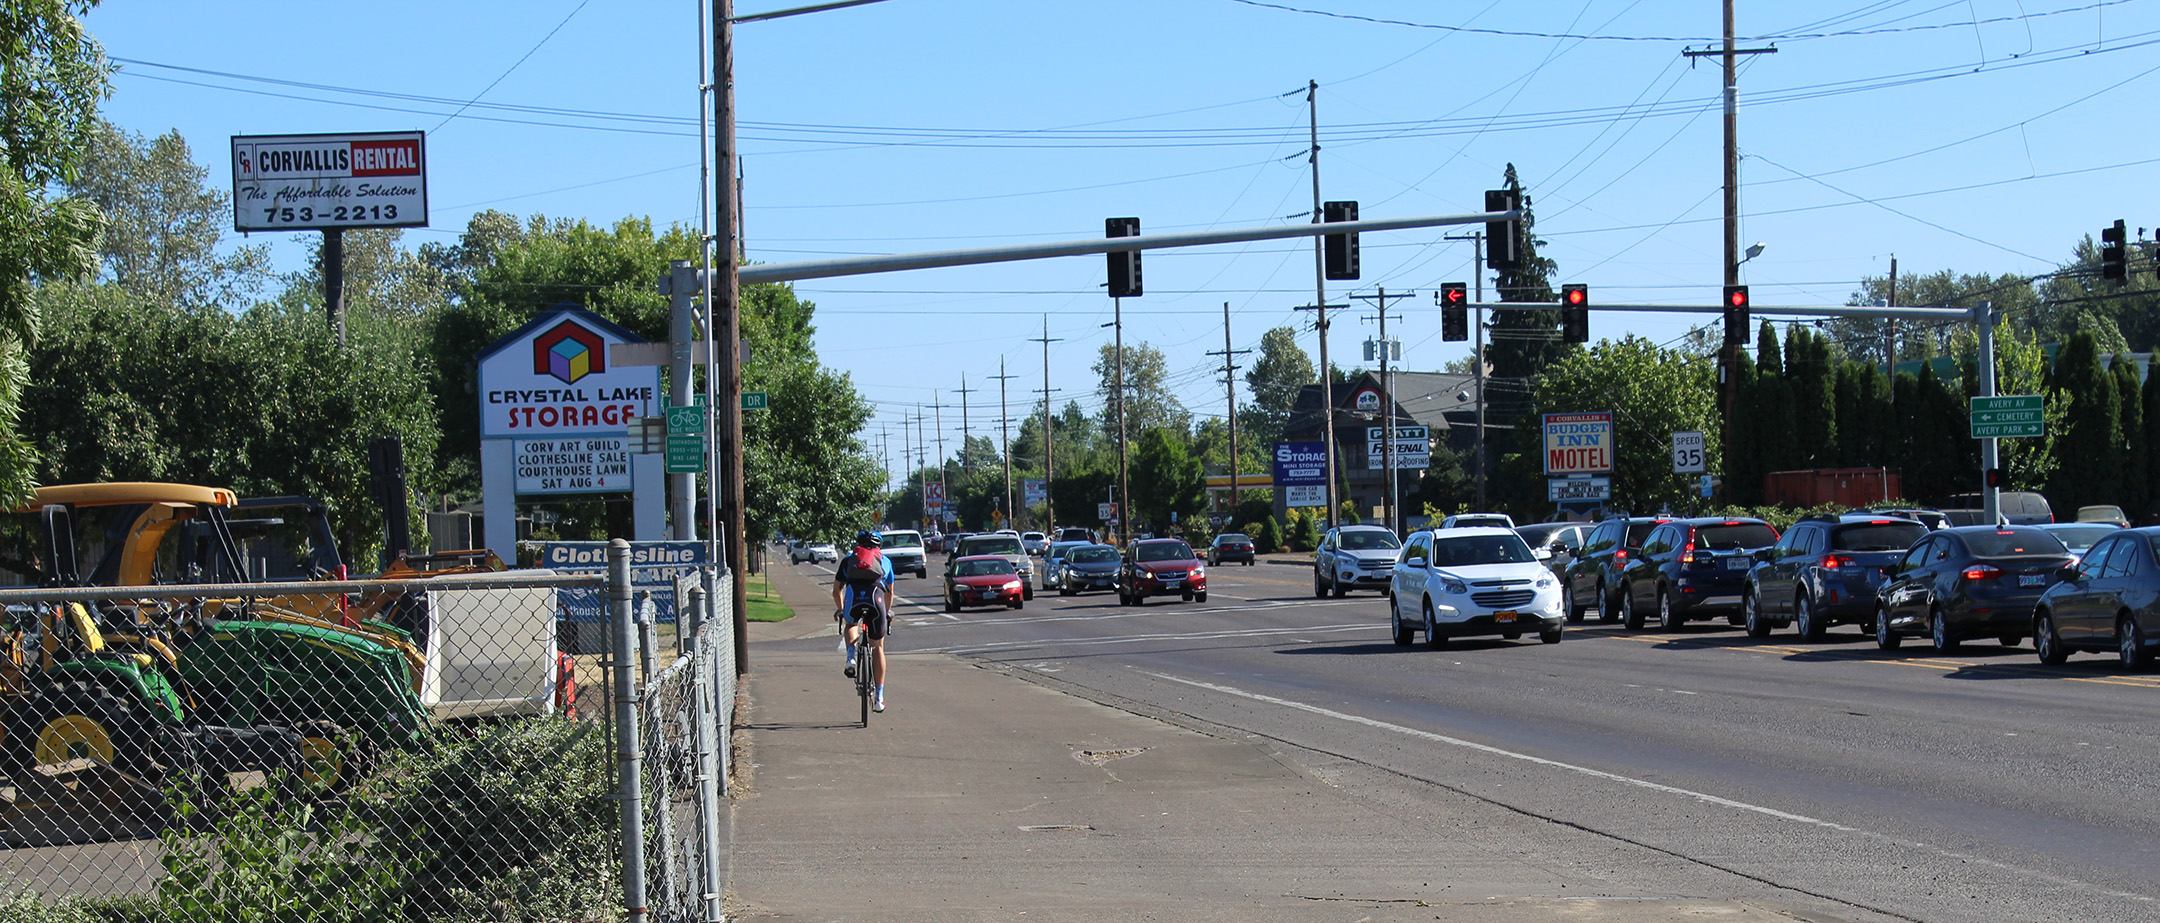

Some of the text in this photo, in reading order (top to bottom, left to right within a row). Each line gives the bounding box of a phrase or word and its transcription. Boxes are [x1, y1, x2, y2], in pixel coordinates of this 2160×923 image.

[259, 147, 417, 173] CORVALLIS RENTAL
[242, 183, 418, 203] The Affordable Solution
[264, 204, 398, 223] 753-2213
[489, 387, 652, 404] CRYSTAL LAKE
[747, 395, 761, 406] DR
[1988, 399, 2026, 409] AVERY AV
[508, 404, 635, 429] STORAGE
[1996, 412, 2035, 421] CEMETERY
[1548, 423, 1609, 434] BUDGET
[1976, 425, 2023, 435] AVERY PARK
[525, 440, 621, 453] CORV ART GUILD
[1557, 434, 1601, 447] INN
[1675, 436, 1700, 446] SPEED
[518, 452, 626, 465] CLOTHESLINE SALE
[1277, 449, 1326, 462] STORAG
[1550, 448, 1609, 470] MOTEL
[1676, 449, 1701, 467] 35
[518, 464, 627, 477] COURTHOUSE LAWN
[542, 477, 605, 489] SAT AUG 4
[1100, 509, 1109, 518] 35
